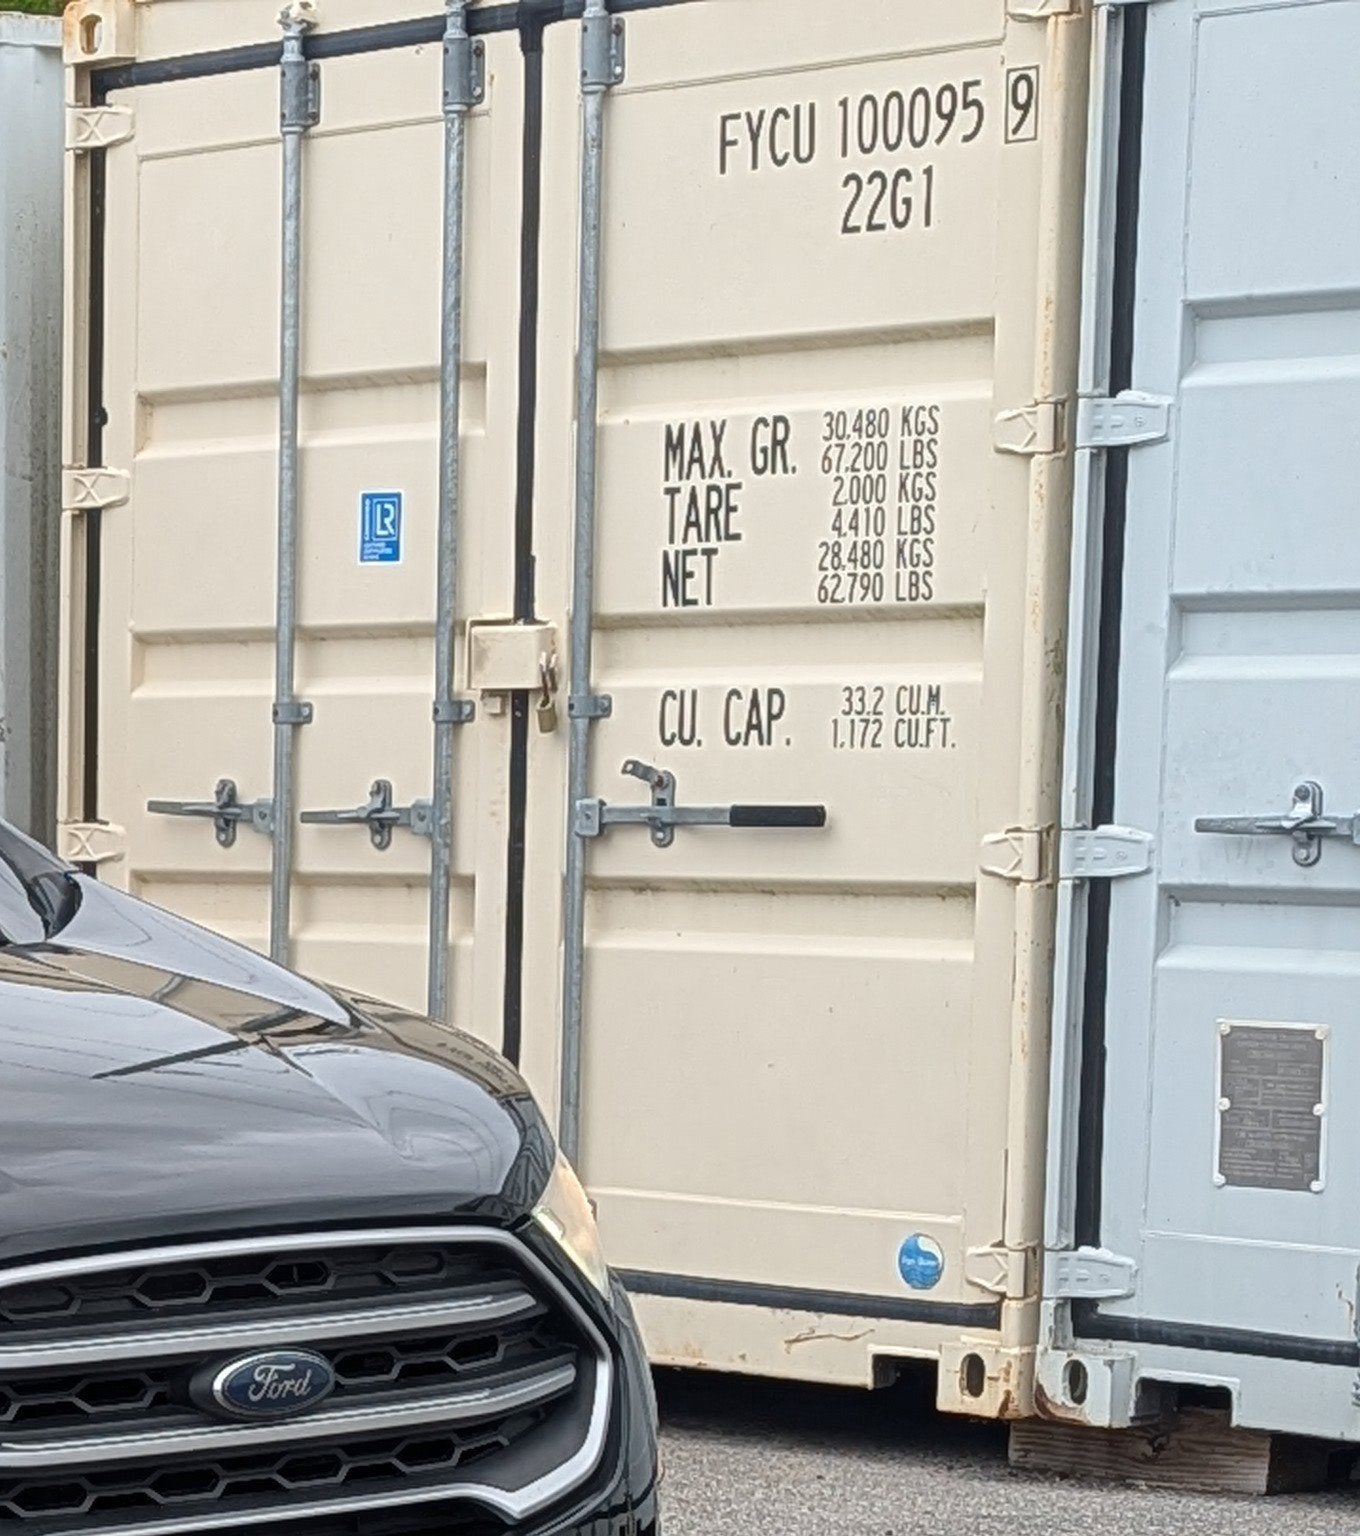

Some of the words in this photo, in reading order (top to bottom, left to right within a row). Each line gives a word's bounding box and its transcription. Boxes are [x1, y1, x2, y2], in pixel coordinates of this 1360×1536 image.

[718, 102, 816, 175] FYCU
[838, 79, 984, 158] 100095
[1010, 72, 1035, 137] 9
[841, 165, 934, 234] 22G1
[664, 419, 732, 482] MAX.
[751, 415, 797, 476] GR.
[822, 407, 890, 441] 30,480
[900, 405, 940, 437] KGS
[899, 438, 938, 470] LBS
[663, 482, 743, 545] TARE
[898, 471, 937, 503] KGS
[897, 504, 936, 535] LBS
[662, 547, 719, 608] NET
[896, 538, 935, 569] KGS
[895, 570, 933, 602] LBS
[659, 689, 702, 748] CU.
[724, 687, 792, 747] CAP.
[841, 685, 885, 716] 33.2
[895, 684, 946, 716] CU.M.
[894, 717, 957, 749] CU.FT.
[247, 1362, 312, 1402] Ford
